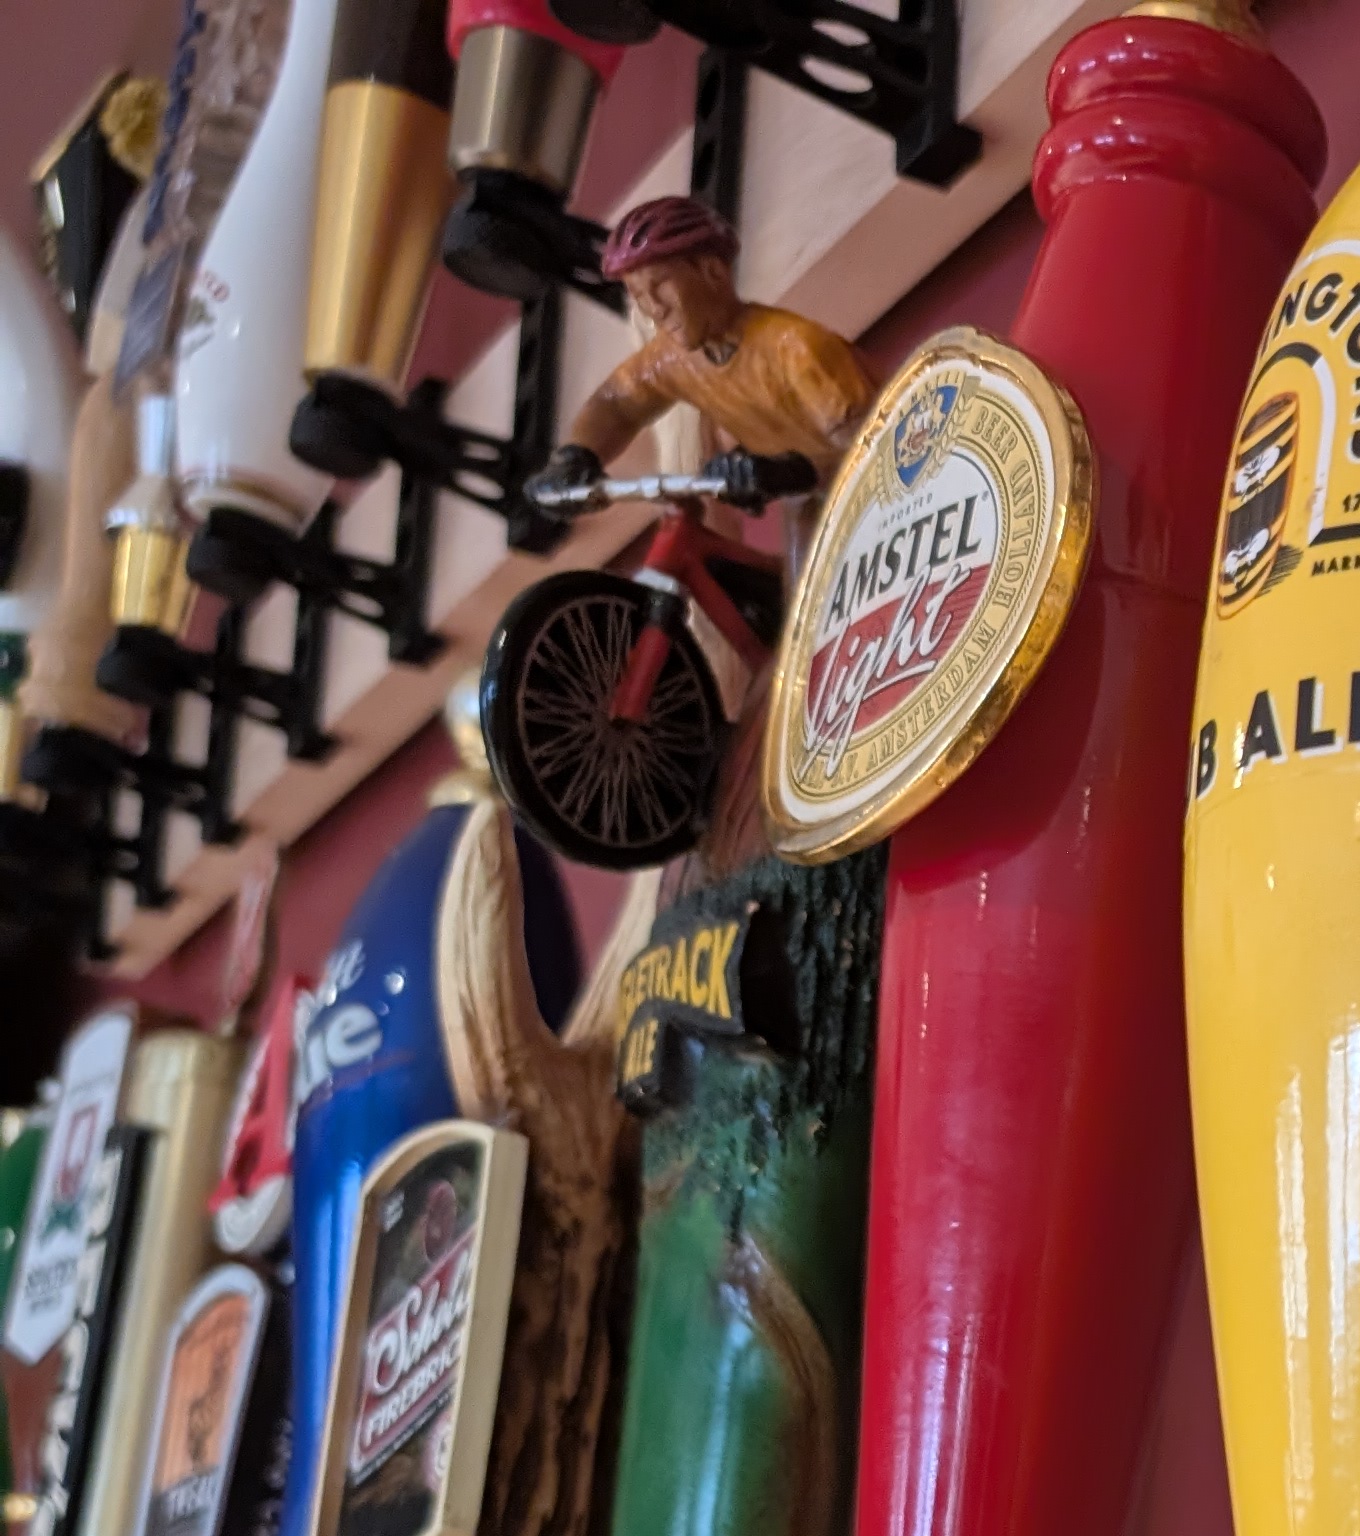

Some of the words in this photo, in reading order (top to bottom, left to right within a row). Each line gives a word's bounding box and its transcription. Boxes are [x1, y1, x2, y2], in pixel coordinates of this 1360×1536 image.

[971, 406, 1018, 463] BEER
[824, 494, 982, 634] AMSTEL
[877, 492, 934, 531] IMPORTED
[994, 459, 1036, 609] HOLLAND
[866, 618, 997, 770] AMSTERDAM
